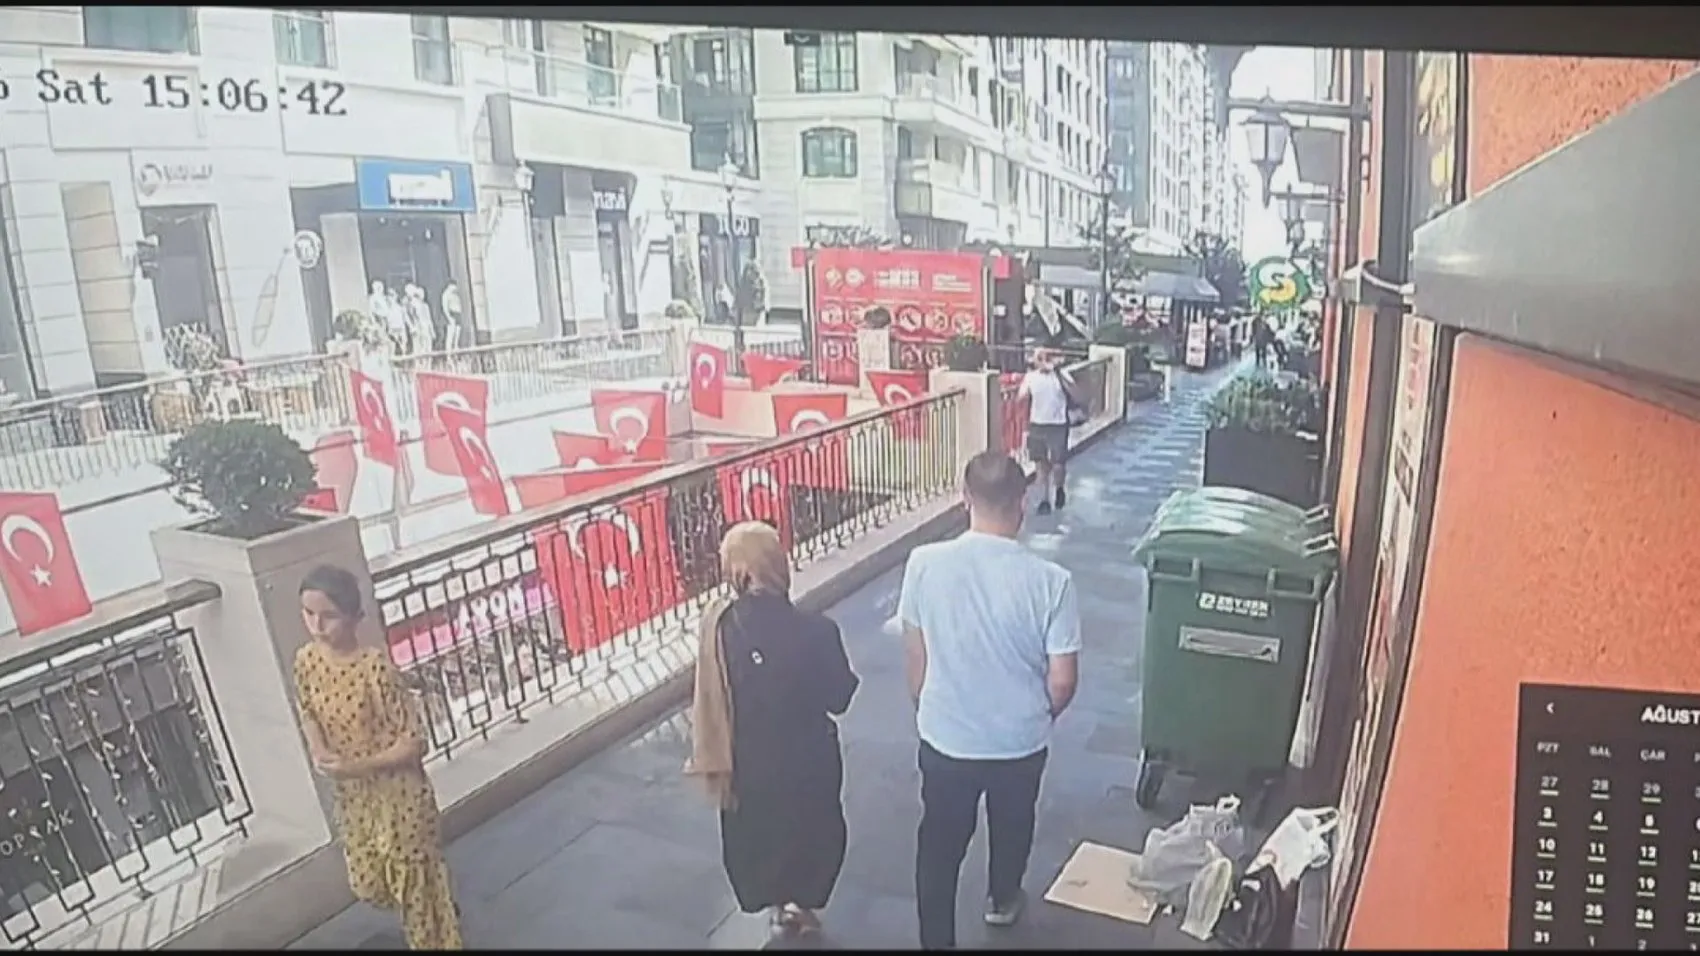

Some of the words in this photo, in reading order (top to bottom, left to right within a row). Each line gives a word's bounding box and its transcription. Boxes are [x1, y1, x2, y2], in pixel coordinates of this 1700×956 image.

[1541, 776, 1558, 788] 27
[1592, 779, 1609, 791] 28
[1643, 783, 1661, 795] 29
[1543, 806, 1552, 819] 3
[1593, 811, 1603, 823] 4
[0, 809, 74, 856] OPAK
[1538, 838, 1556, 851] 10
[1590, 842, 1605, 855] 11
[1640, 846, 1657, 859] 12
[1537, 870, 1554, 882] 17
[1588, 873, 1604, 886] 18
[1638, 877, 1656, 889] 19
[1535, 900, 1553, 913] 24
[1585, 904, 1603, 917] 25
[1636, 908, 1653, 921] 26
[1534, 931, 1550, 943] 31
[1589, 936, 1595, 947] 1
